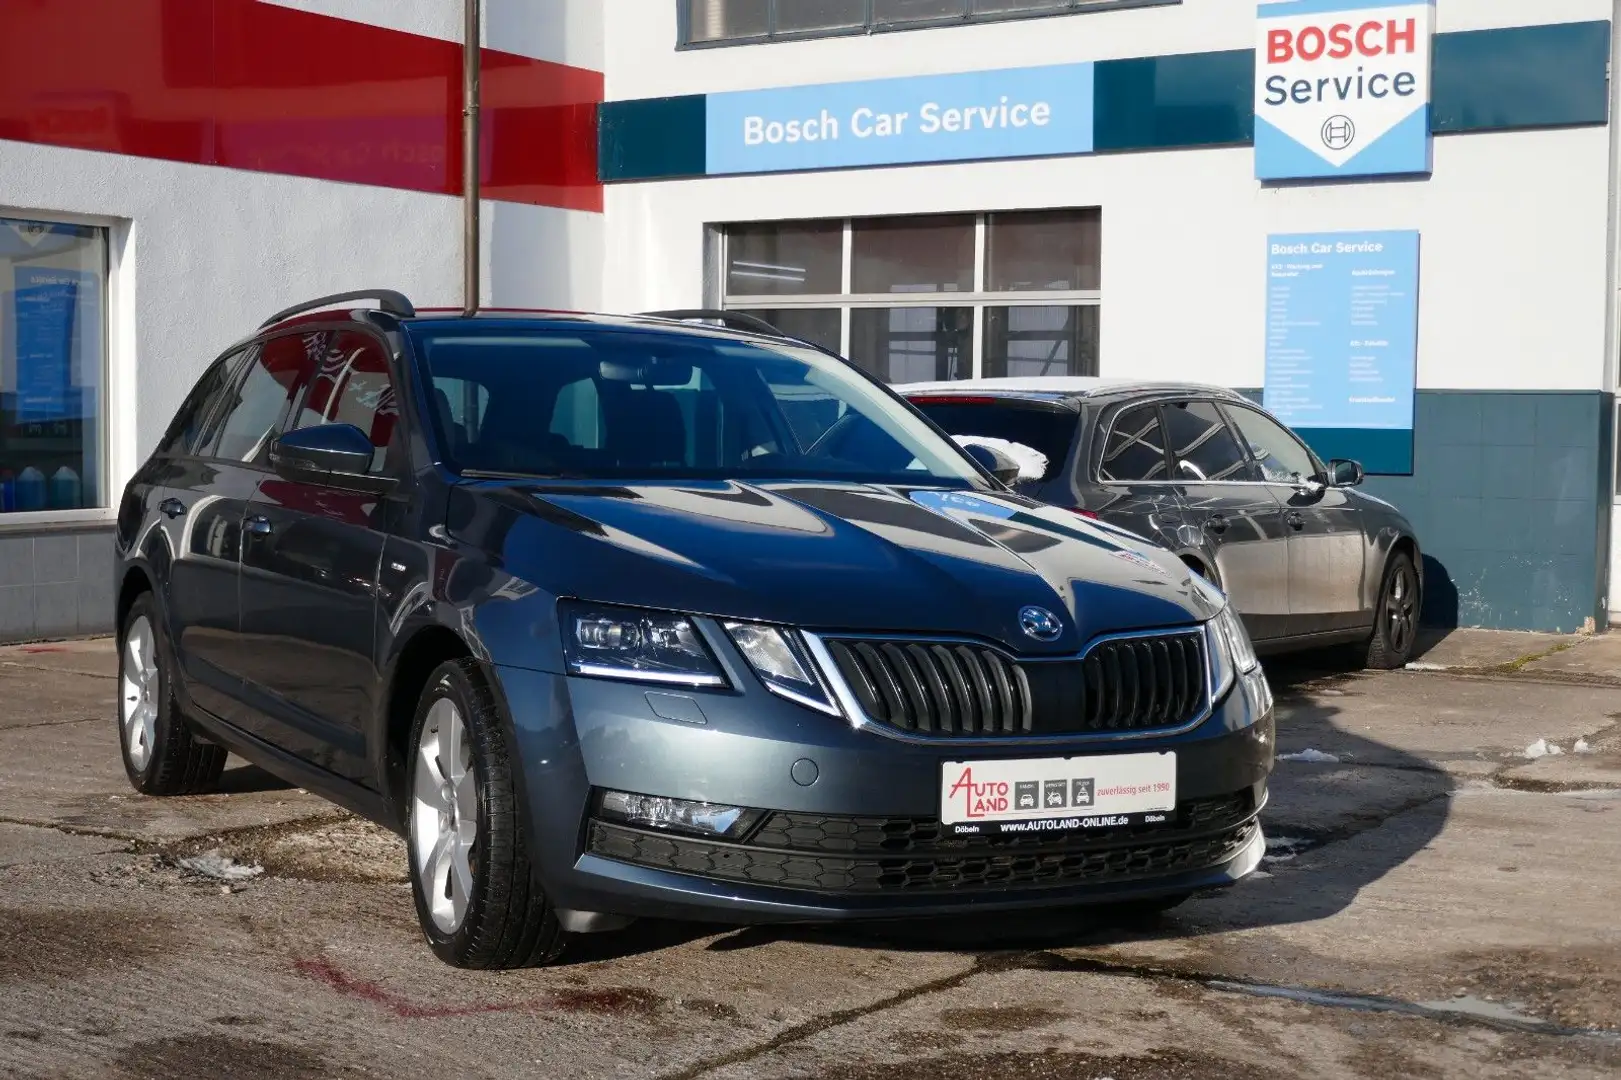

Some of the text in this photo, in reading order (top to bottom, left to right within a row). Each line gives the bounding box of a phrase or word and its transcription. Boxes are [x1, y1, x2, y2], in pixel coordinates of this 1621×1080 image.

[1267, 18, 1416, 64] BOSCH
[1264, 66, 1416, 106] Service
[744, 96, 1051, 146] Bosch Car Service
[1271, 240, 1384, 255] Bosch Car Service
[949, 767, 1009, 799] AUTO
[1138, 784, 1152, 793] seit
[1153, 782, 1170, 793] 1990
[967, 796, 1009, 817] LAND
[1000, 815, 1129, 832] www.AUTOLAND-ONLINE.de
[1144, 814, 1166, 823] Döbeln
[955, 825, 980, 834] Döbeln
